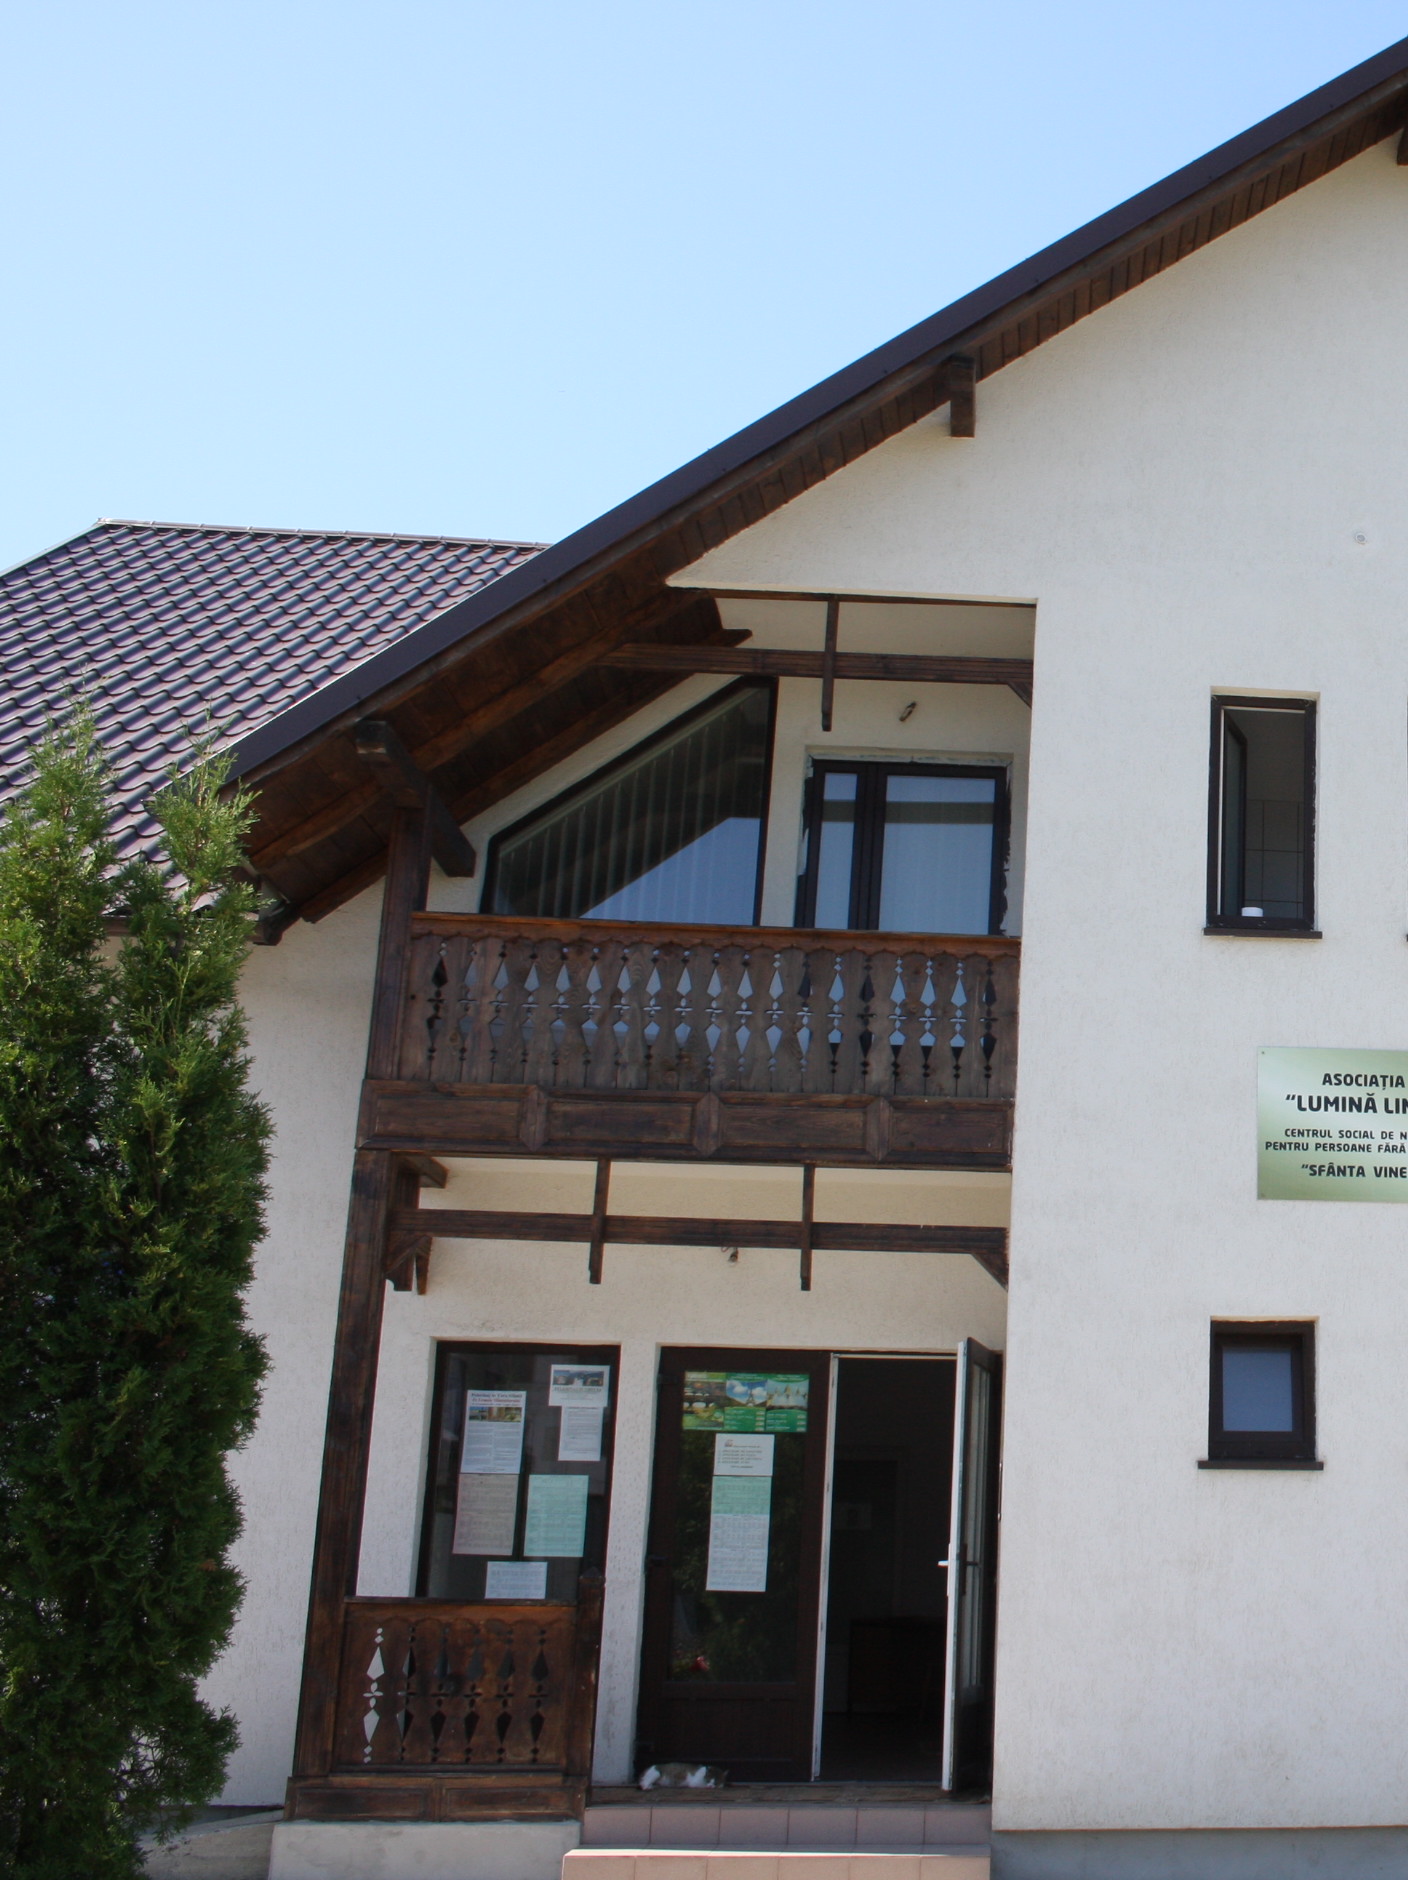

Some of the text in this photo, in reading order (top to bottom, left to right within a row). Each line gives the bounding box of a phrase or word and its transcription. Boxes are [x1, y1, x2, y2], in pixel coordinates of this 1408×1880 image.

[1321, 1073, 1406, 1091] ASOCIAȚIA
[1285, 1093, 1378, 1114] “LUMINĂ
[1284, 1128, 1333, 1139] CENTRUL
[1337, 1129, 1376, 1140] SOCIAL
[1380, 1130, 1395, 1141] DE
[1264, 1141, 1310, 1152] PENTRU
[1314, 1142, 1373, 1154] PERSOANE
[1377, 1141, 1407, 1155] FĂRĂ
[1301, 1162, 1366, 1178] “SFÂNTA
